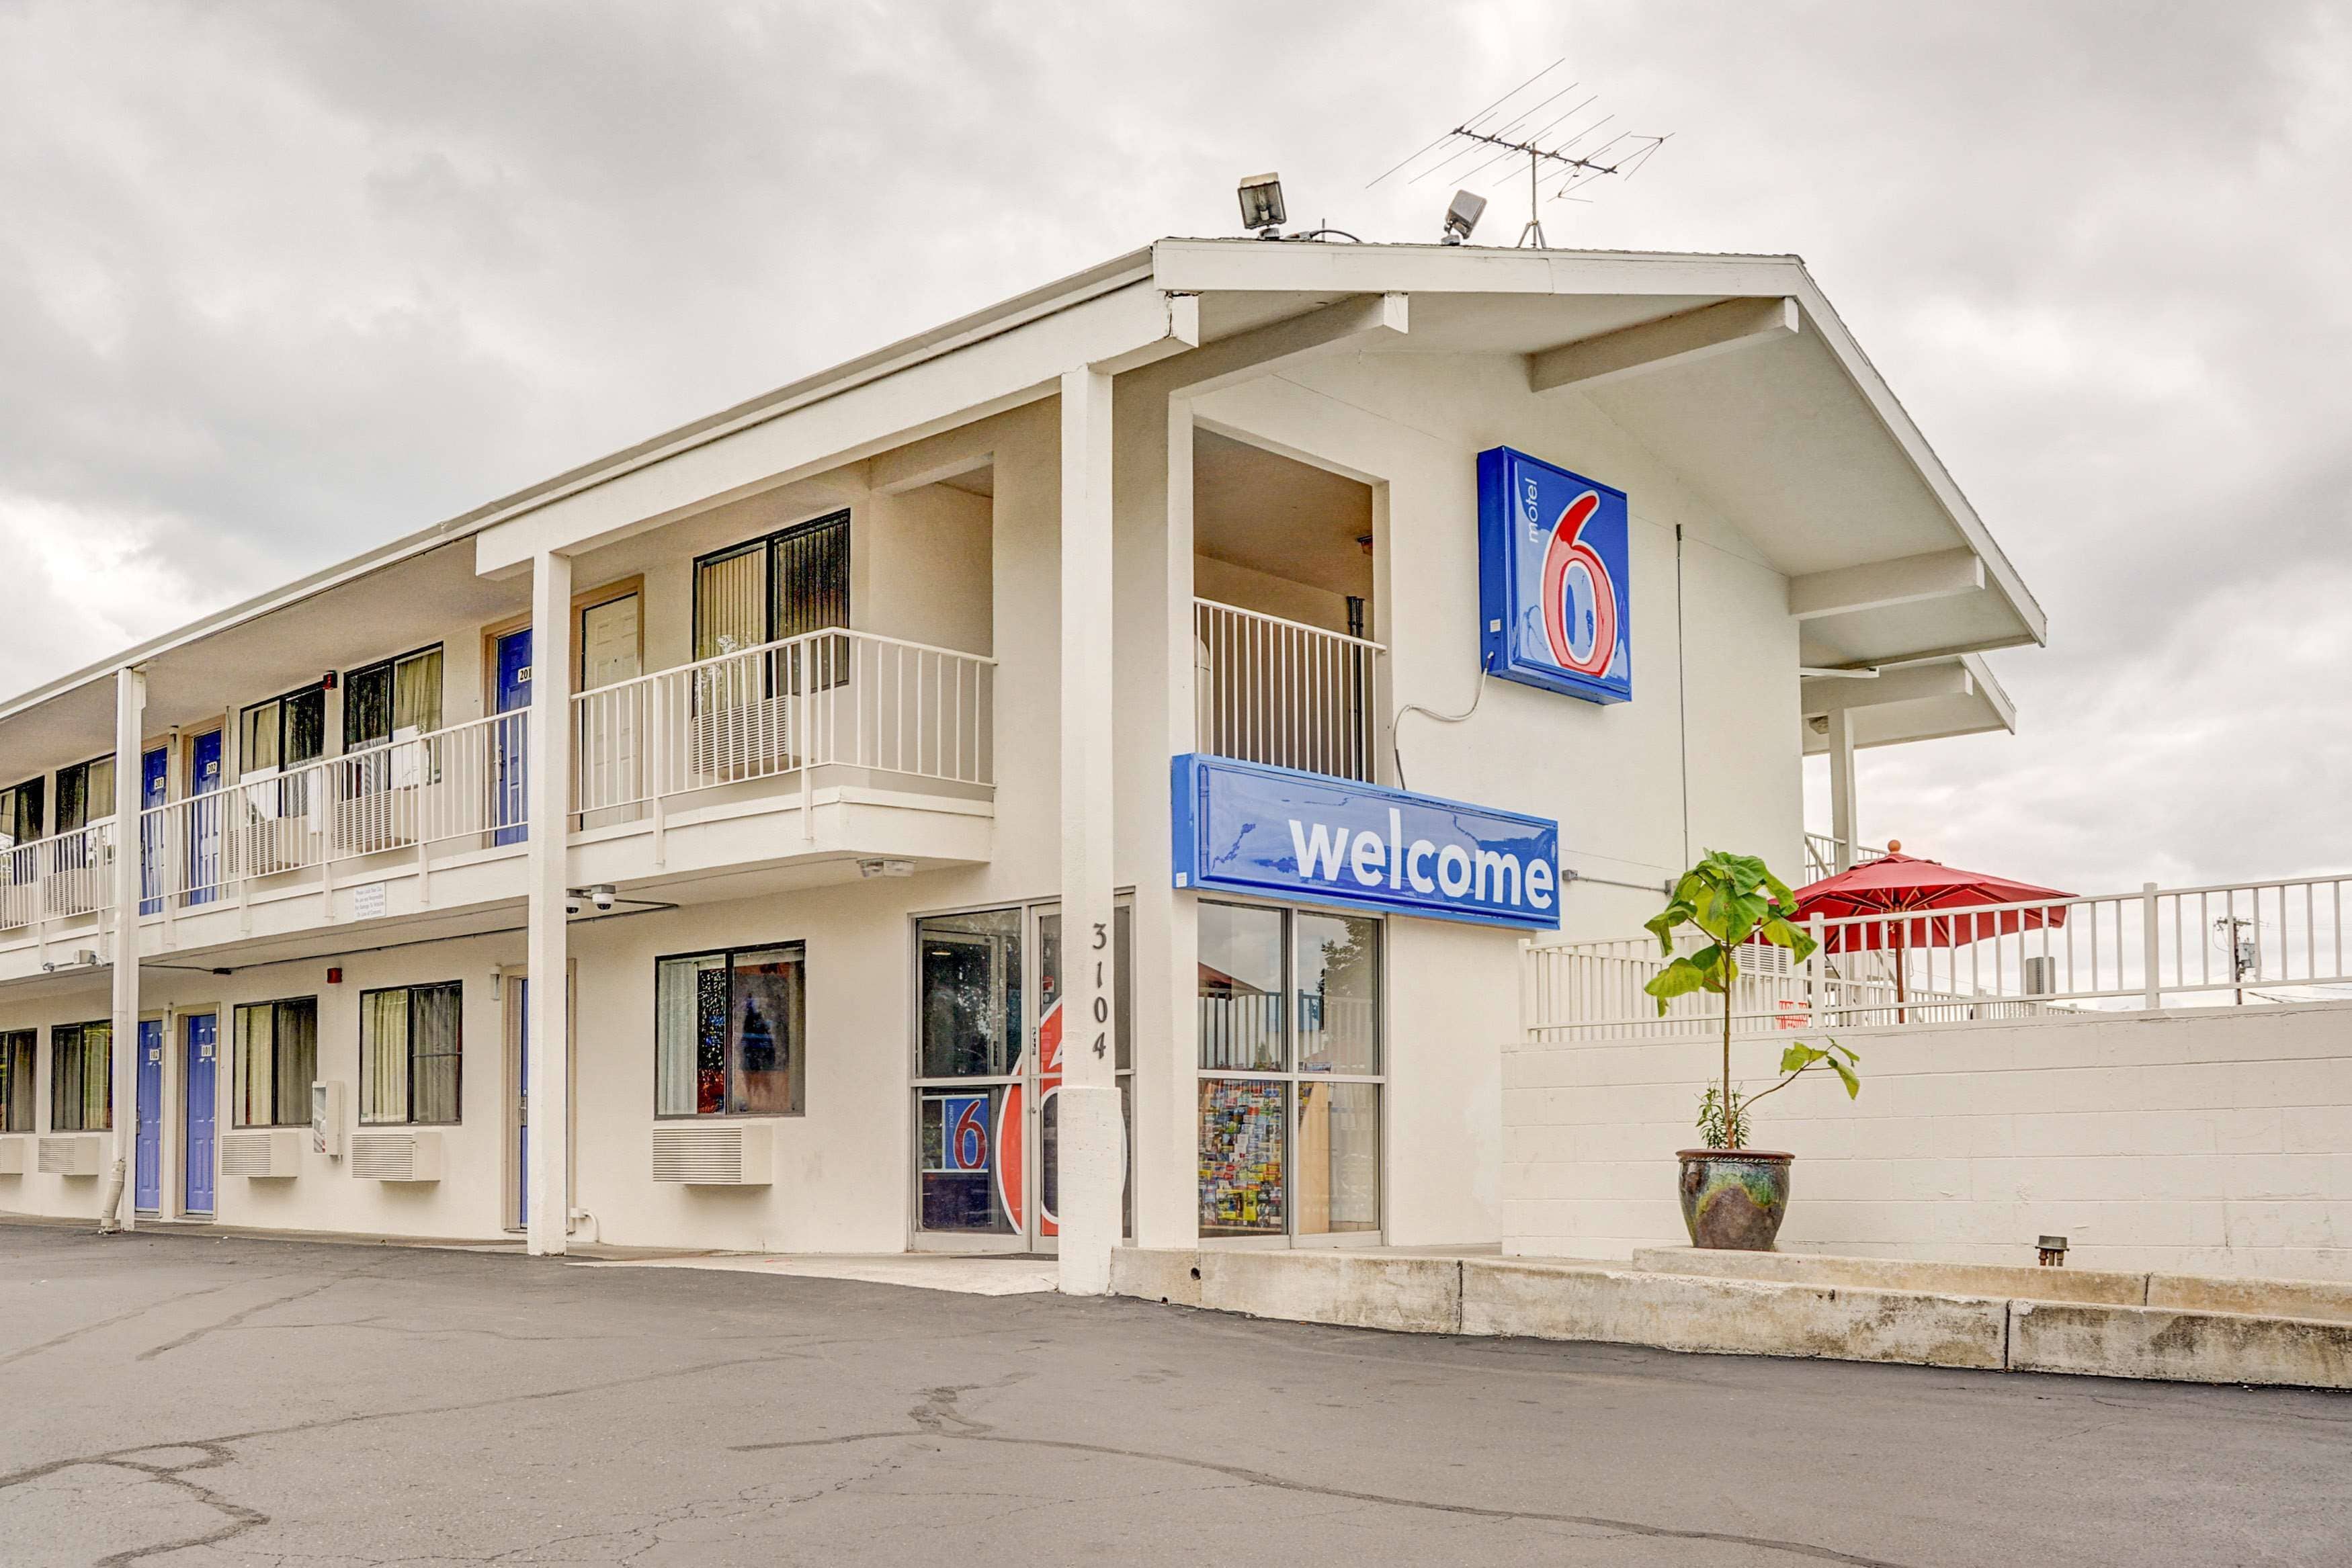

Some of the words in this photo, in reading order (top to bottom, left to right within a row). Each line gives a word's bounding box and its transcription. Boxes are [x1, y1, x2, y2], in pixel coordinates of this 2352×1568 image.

[1525, 478, 1538, 543] motel
[1540, 490, 1618, 679] 6
[519, 668, 531, 681] 201
[1288, 808, 1554, 909] welcome
[1093, 922, 1107, 1059] 3104
[953, 1099, 987, 1170] 6
